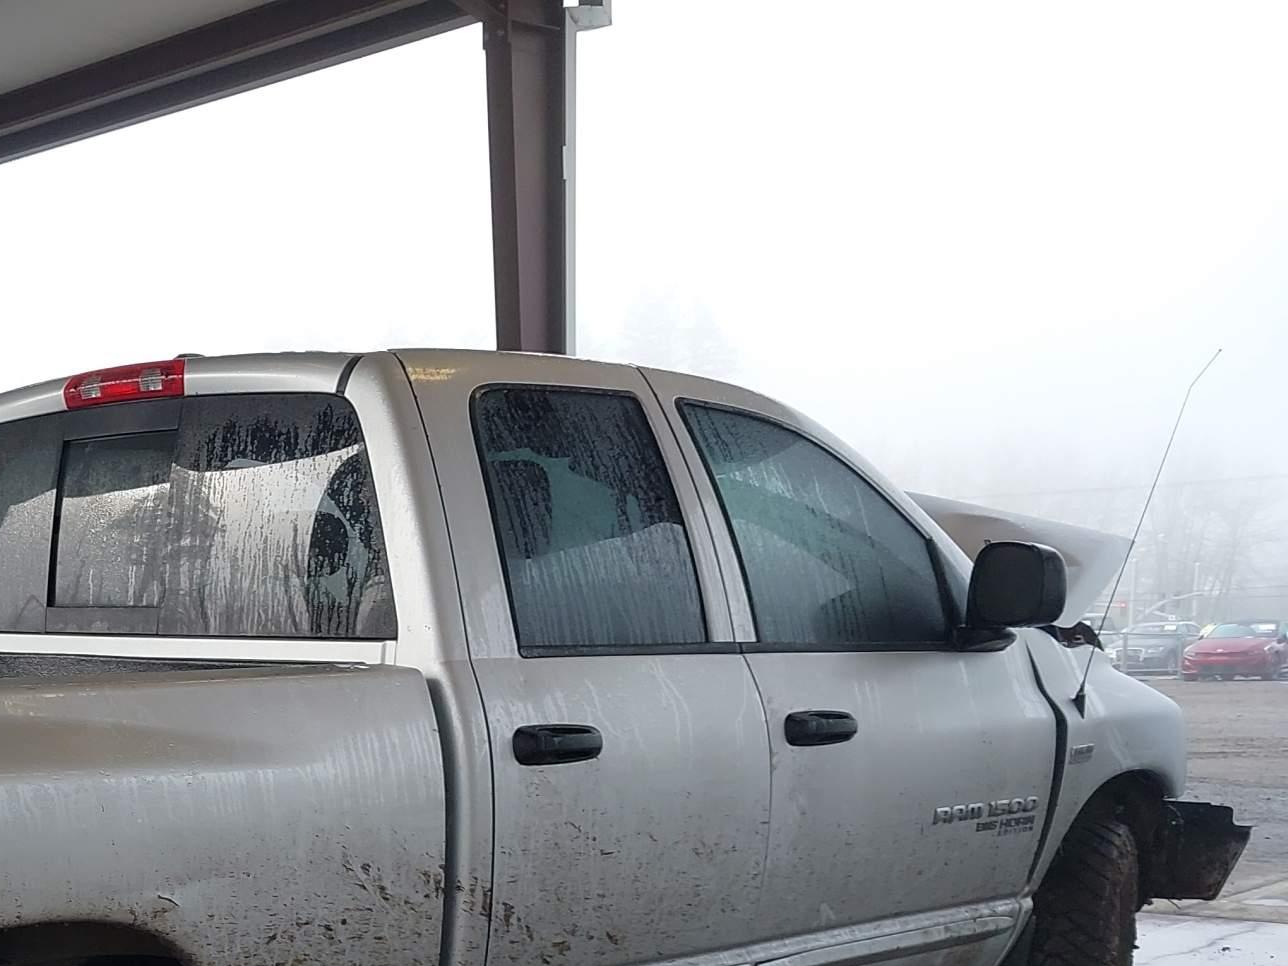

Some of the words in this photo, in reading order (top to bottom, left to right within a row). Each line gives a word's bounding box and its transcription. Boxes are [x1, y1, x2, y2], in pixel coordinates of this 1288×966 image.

[933, 803, 984, 825] RAM
[987, 796, 1039, 817] 1500
[999, 815, 1035, 828] HORN
